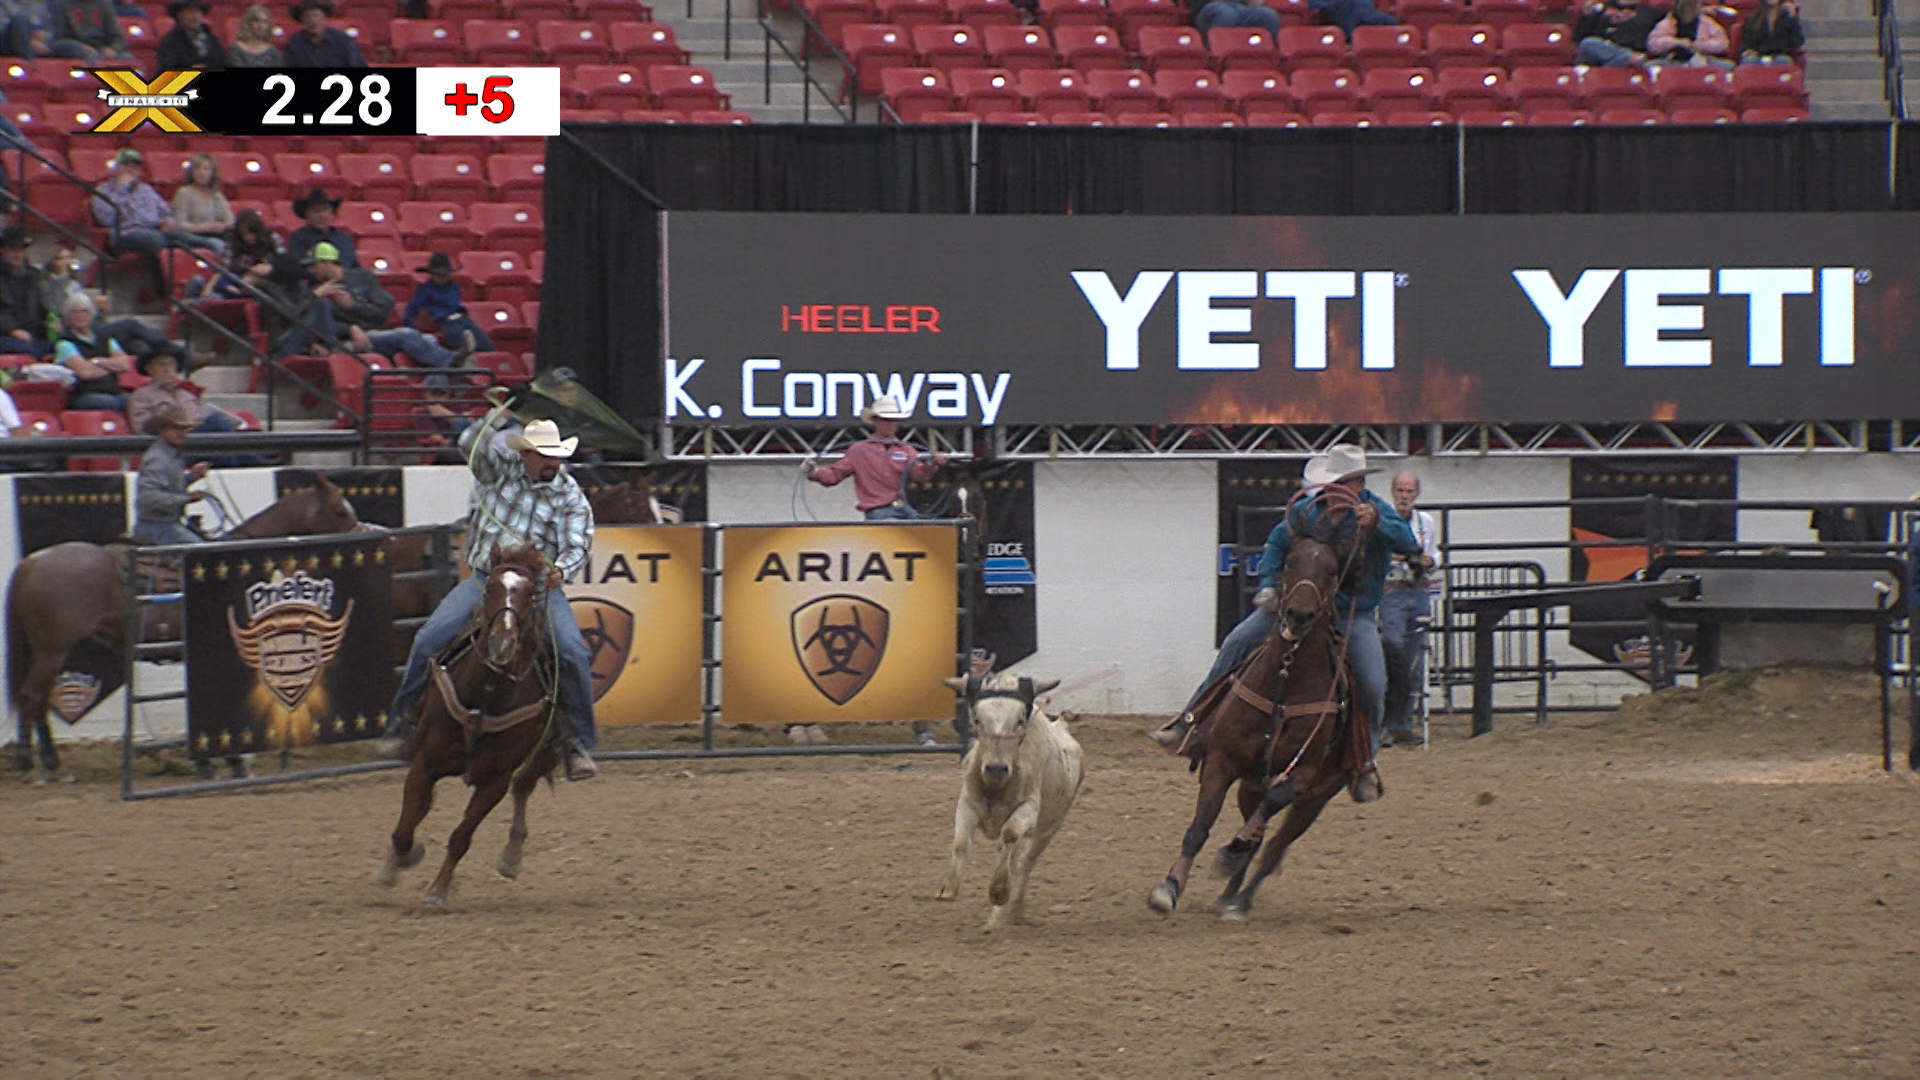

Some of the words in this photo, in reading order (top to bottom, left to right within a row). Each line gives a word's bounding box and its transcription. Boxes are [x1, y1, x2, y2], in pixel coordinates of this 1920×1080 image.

[781, 304, 941, 333] HEELER
[664, 358, 723, 418] K.
[742, 359, 1011, 426] Conway
[563, 552, 672, 584] IAT
[754, 551, 927, 582] ARIAT
